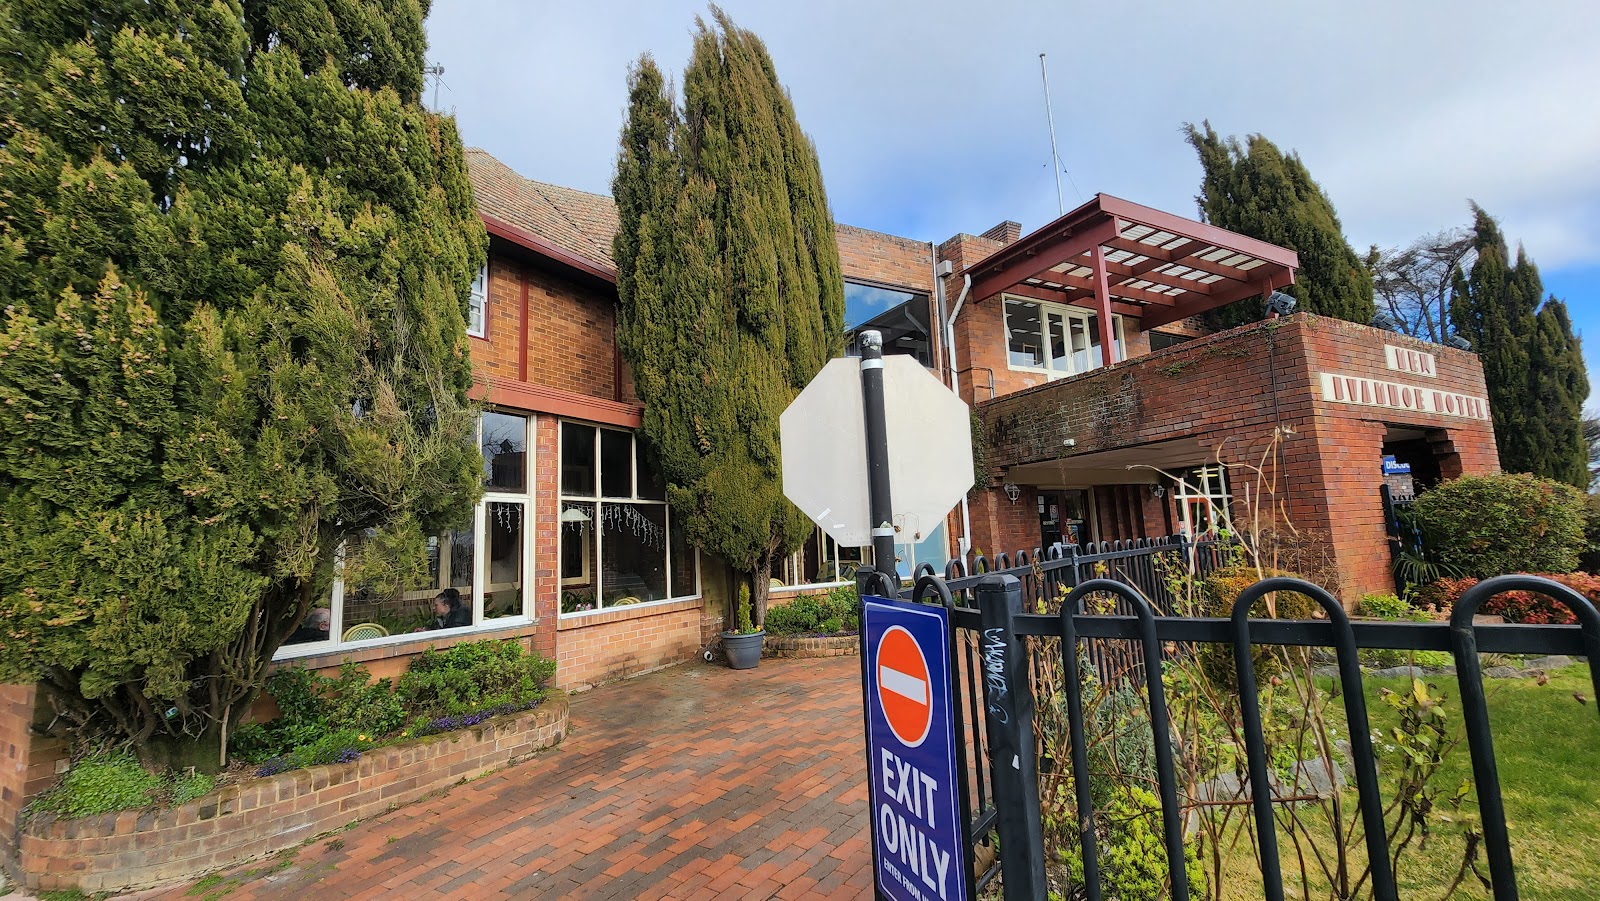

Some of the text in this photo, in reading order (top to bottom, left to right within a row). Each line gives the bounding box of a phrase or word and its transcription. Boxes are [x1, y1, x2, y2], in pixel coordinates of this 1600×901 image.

[1395, 348, 1430, 374] NEW
[1332, 376, 1484, 419] IVANHOE HOTEL
[881, 746, 938, 830] EXIT
[880, 802, 950, 901] ONLY
[883, 856, 921, 901] ENTER FROM
